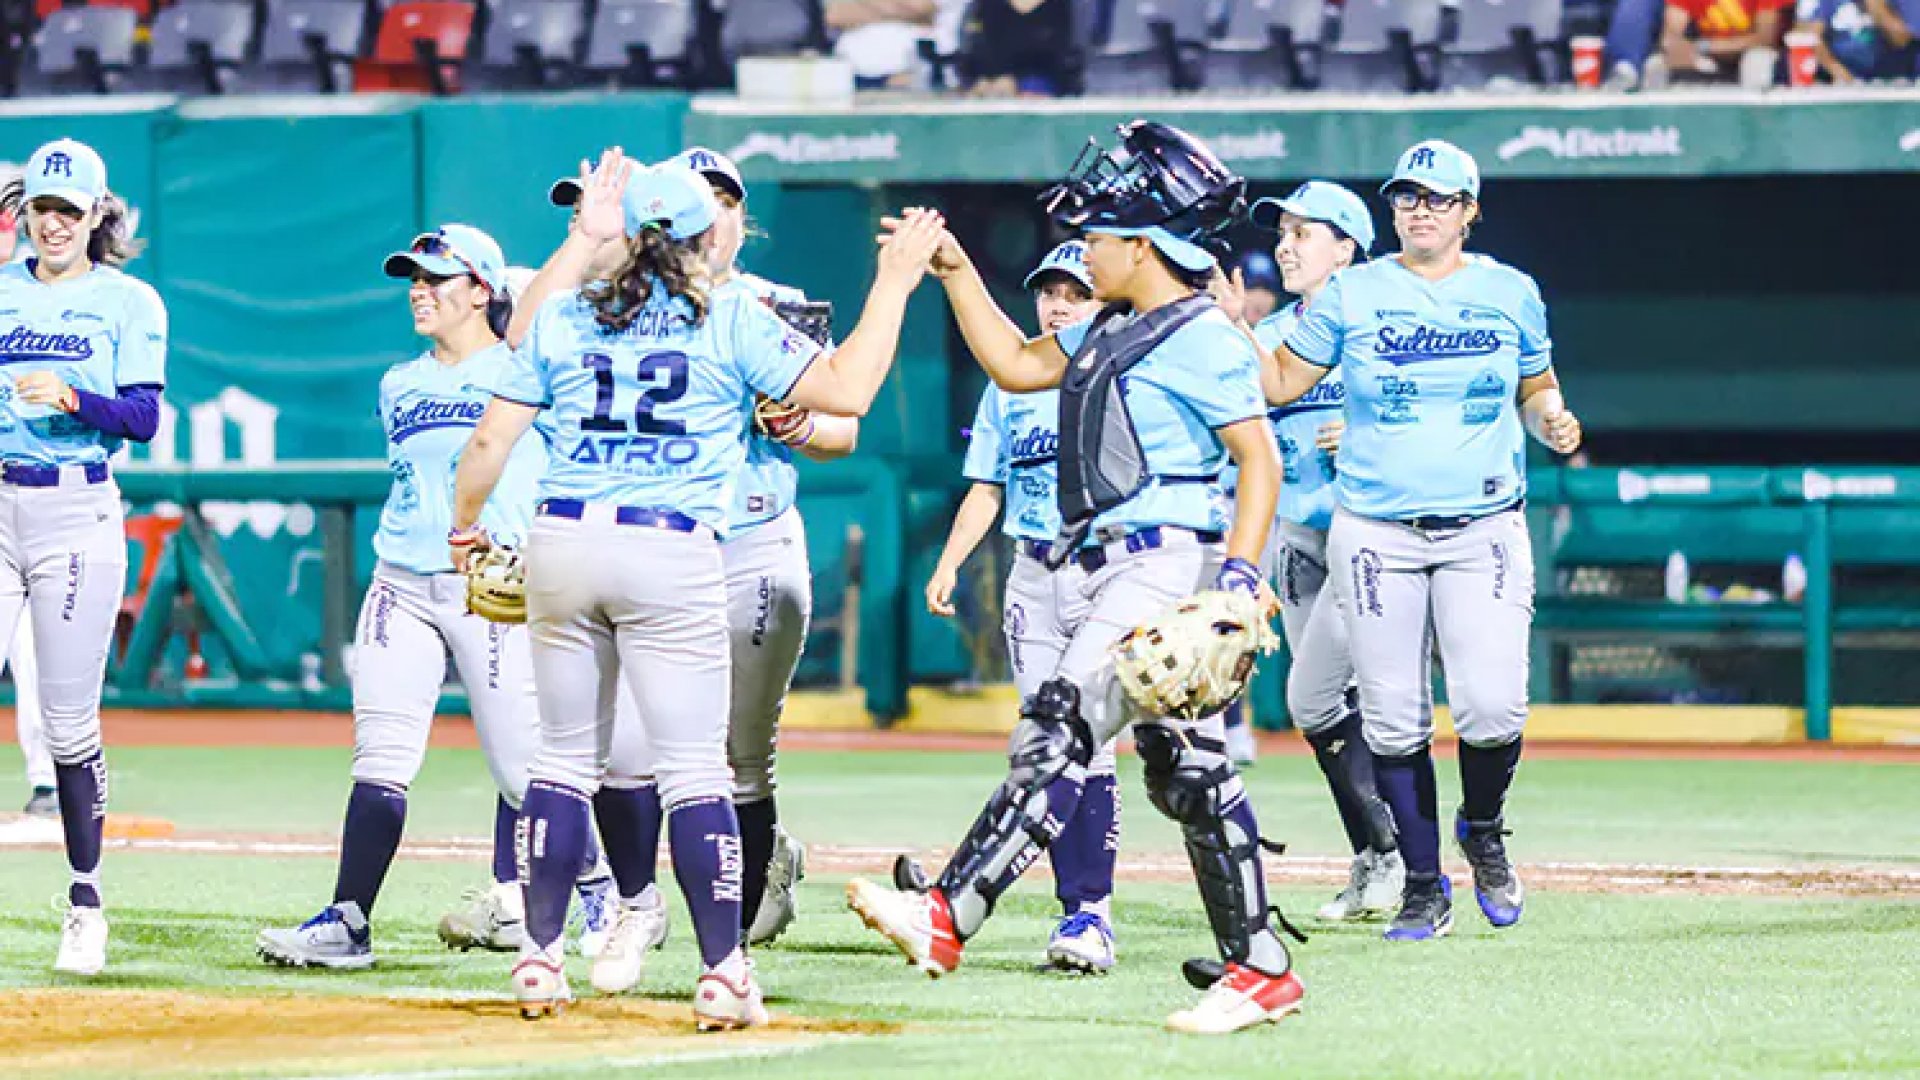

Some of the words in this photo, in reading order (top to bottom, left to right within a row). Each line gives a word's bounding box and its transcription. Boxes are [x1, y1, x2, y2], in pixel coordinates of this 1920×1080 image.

[1374, 325, 1502, 358] Sultanes
[579, 350, 689, 437] 12
[389, 399, 486, 434] Sultane
[569, 436, 700, 466] ATRO
